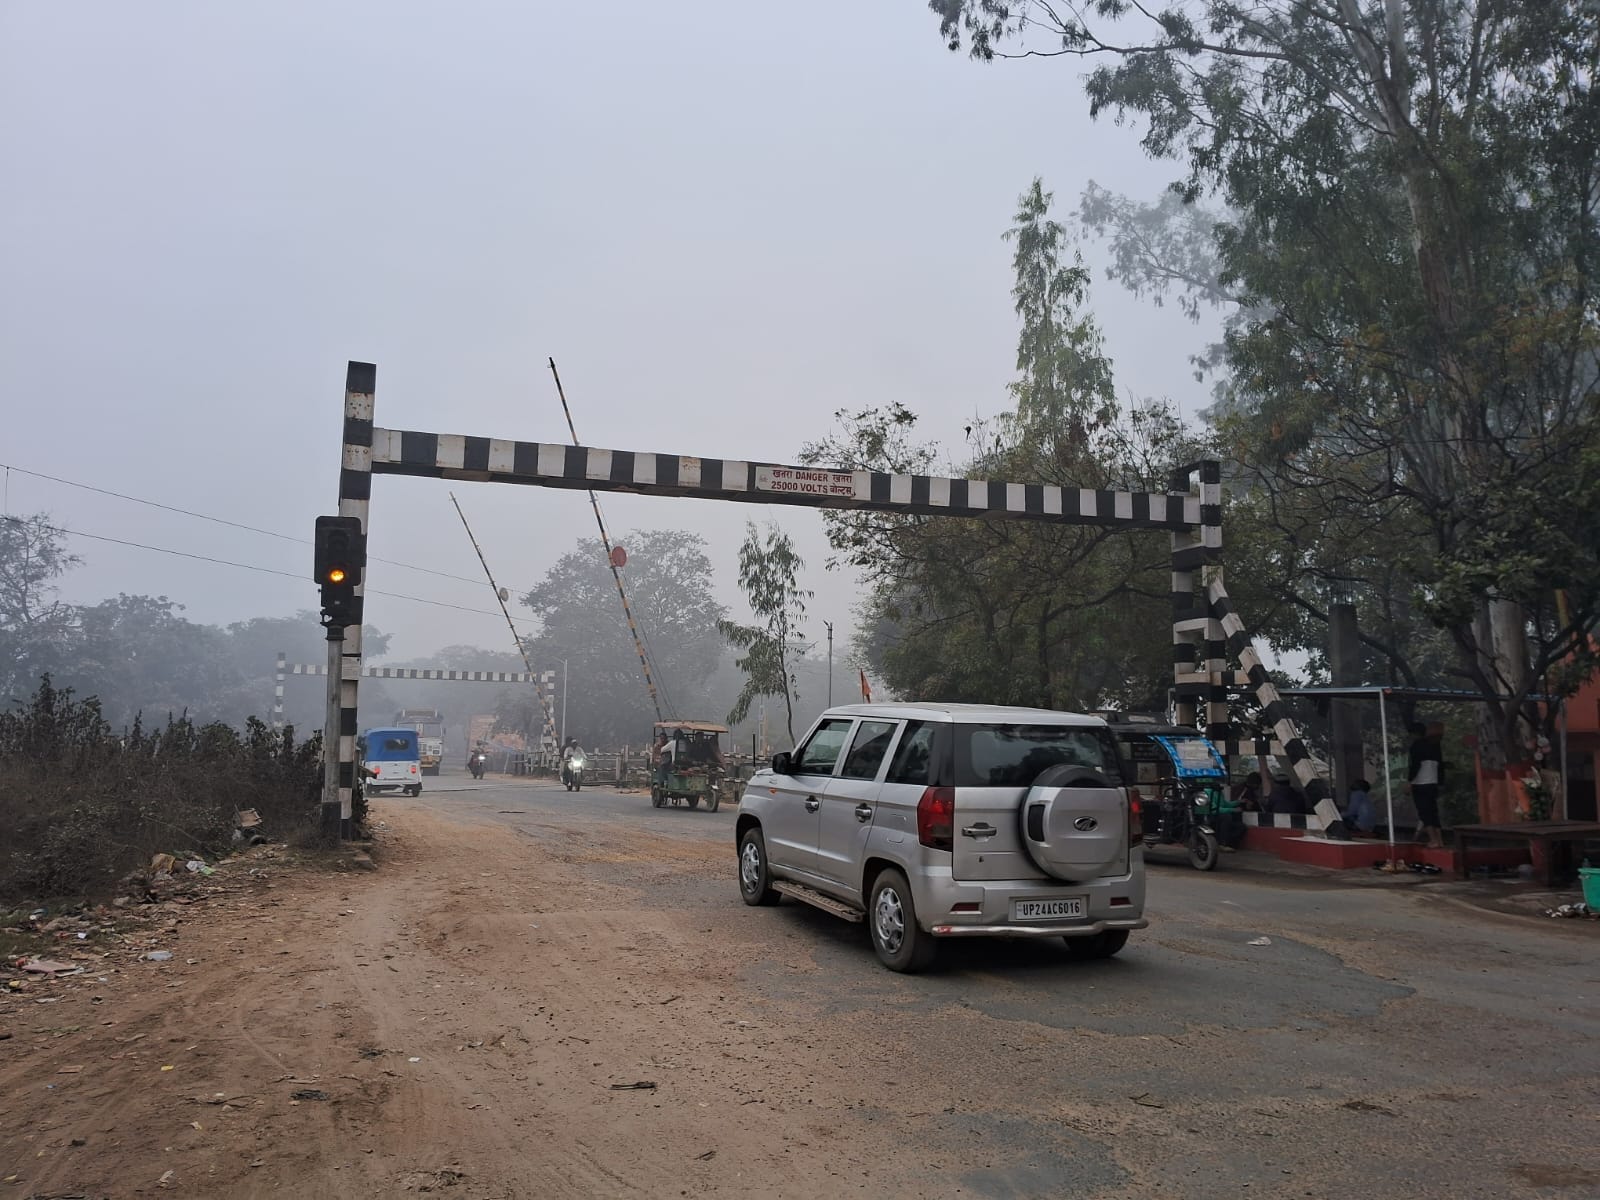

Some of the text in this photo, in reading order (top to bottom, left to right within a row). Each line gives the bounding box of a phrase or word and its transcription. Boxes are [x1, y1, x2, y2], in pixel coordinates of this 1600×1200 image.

[772, 470, 852, 483] खतरा DANGER खतरा
[771, 481, 798, 491] 25000
[800, 483, 828, 494] VOLTS
[1022, 902, 1080, 916] UP24AC6016
